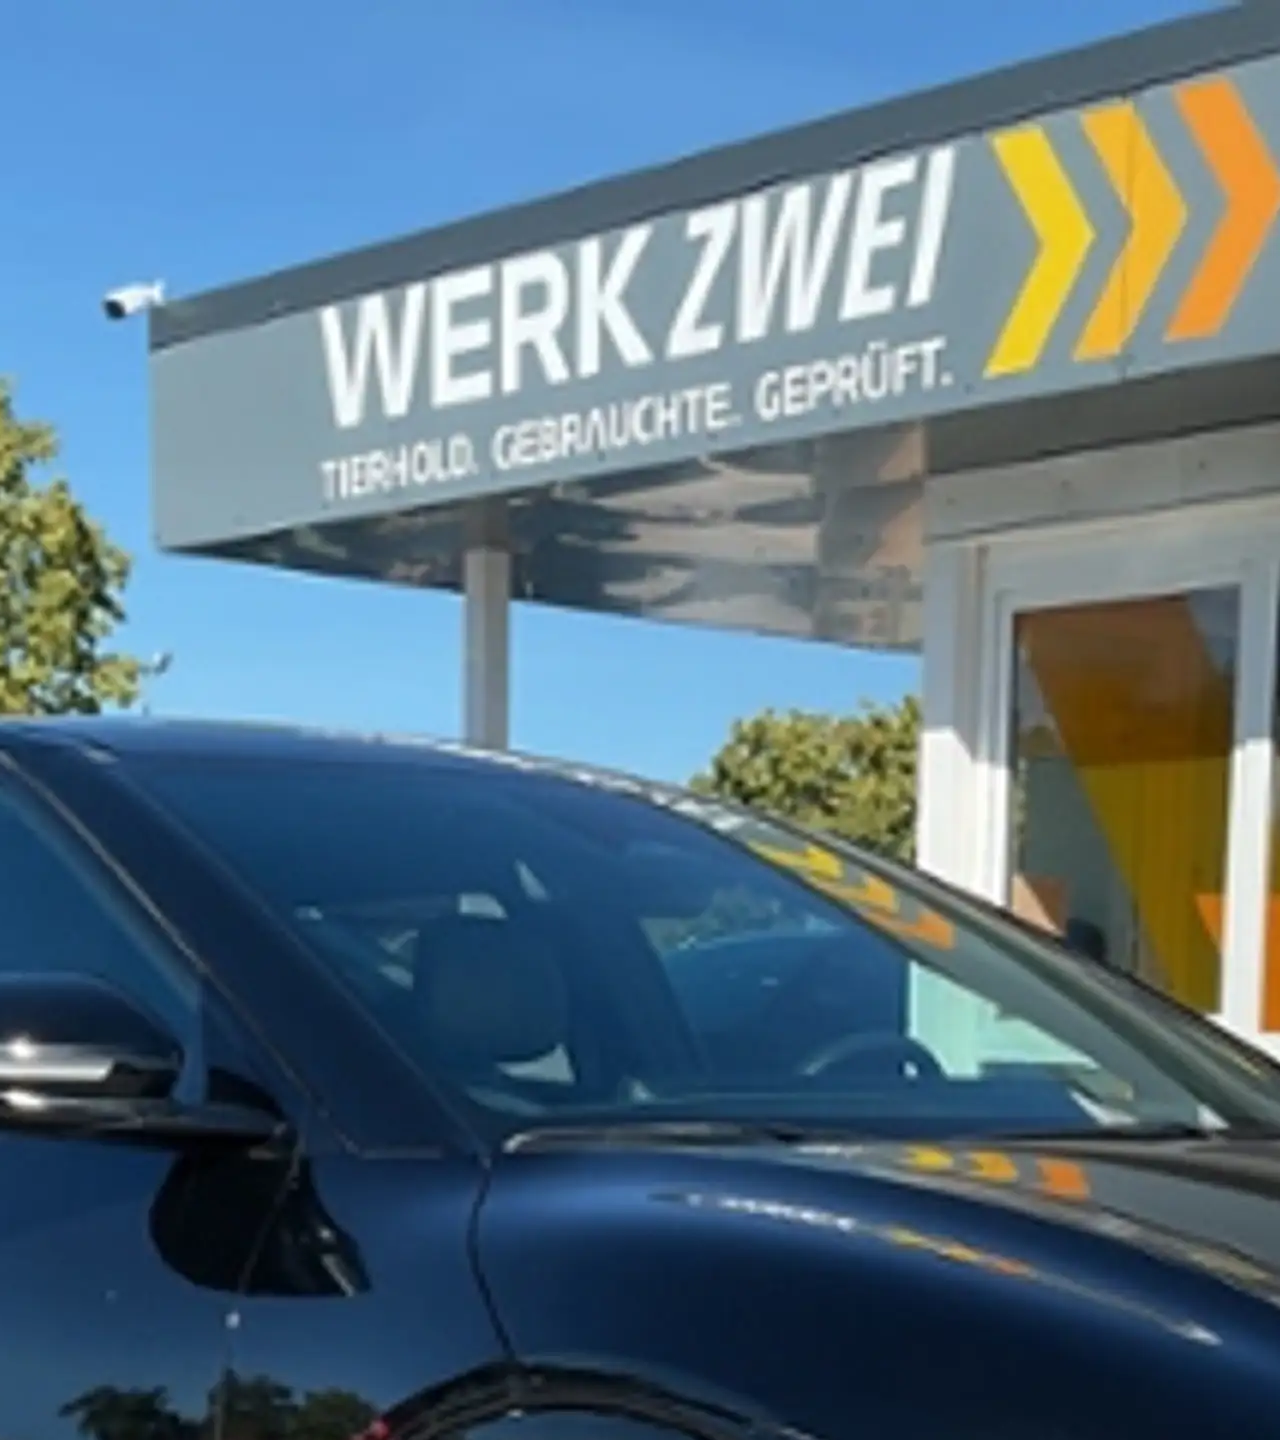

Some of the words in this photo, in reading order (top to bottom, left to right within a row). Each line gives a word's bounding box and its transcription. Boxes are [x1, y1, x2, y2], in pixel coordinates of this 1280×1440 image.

[321, 223, 656, 427] WERK
[666, 147, 956, 360] ZWEI
[319, 433, 479, 500] TIERHOLD.
[491, 381, 742, 469] GEBRAUCHTE.
[754, 335, 955, 422] GEPRÜFT.
